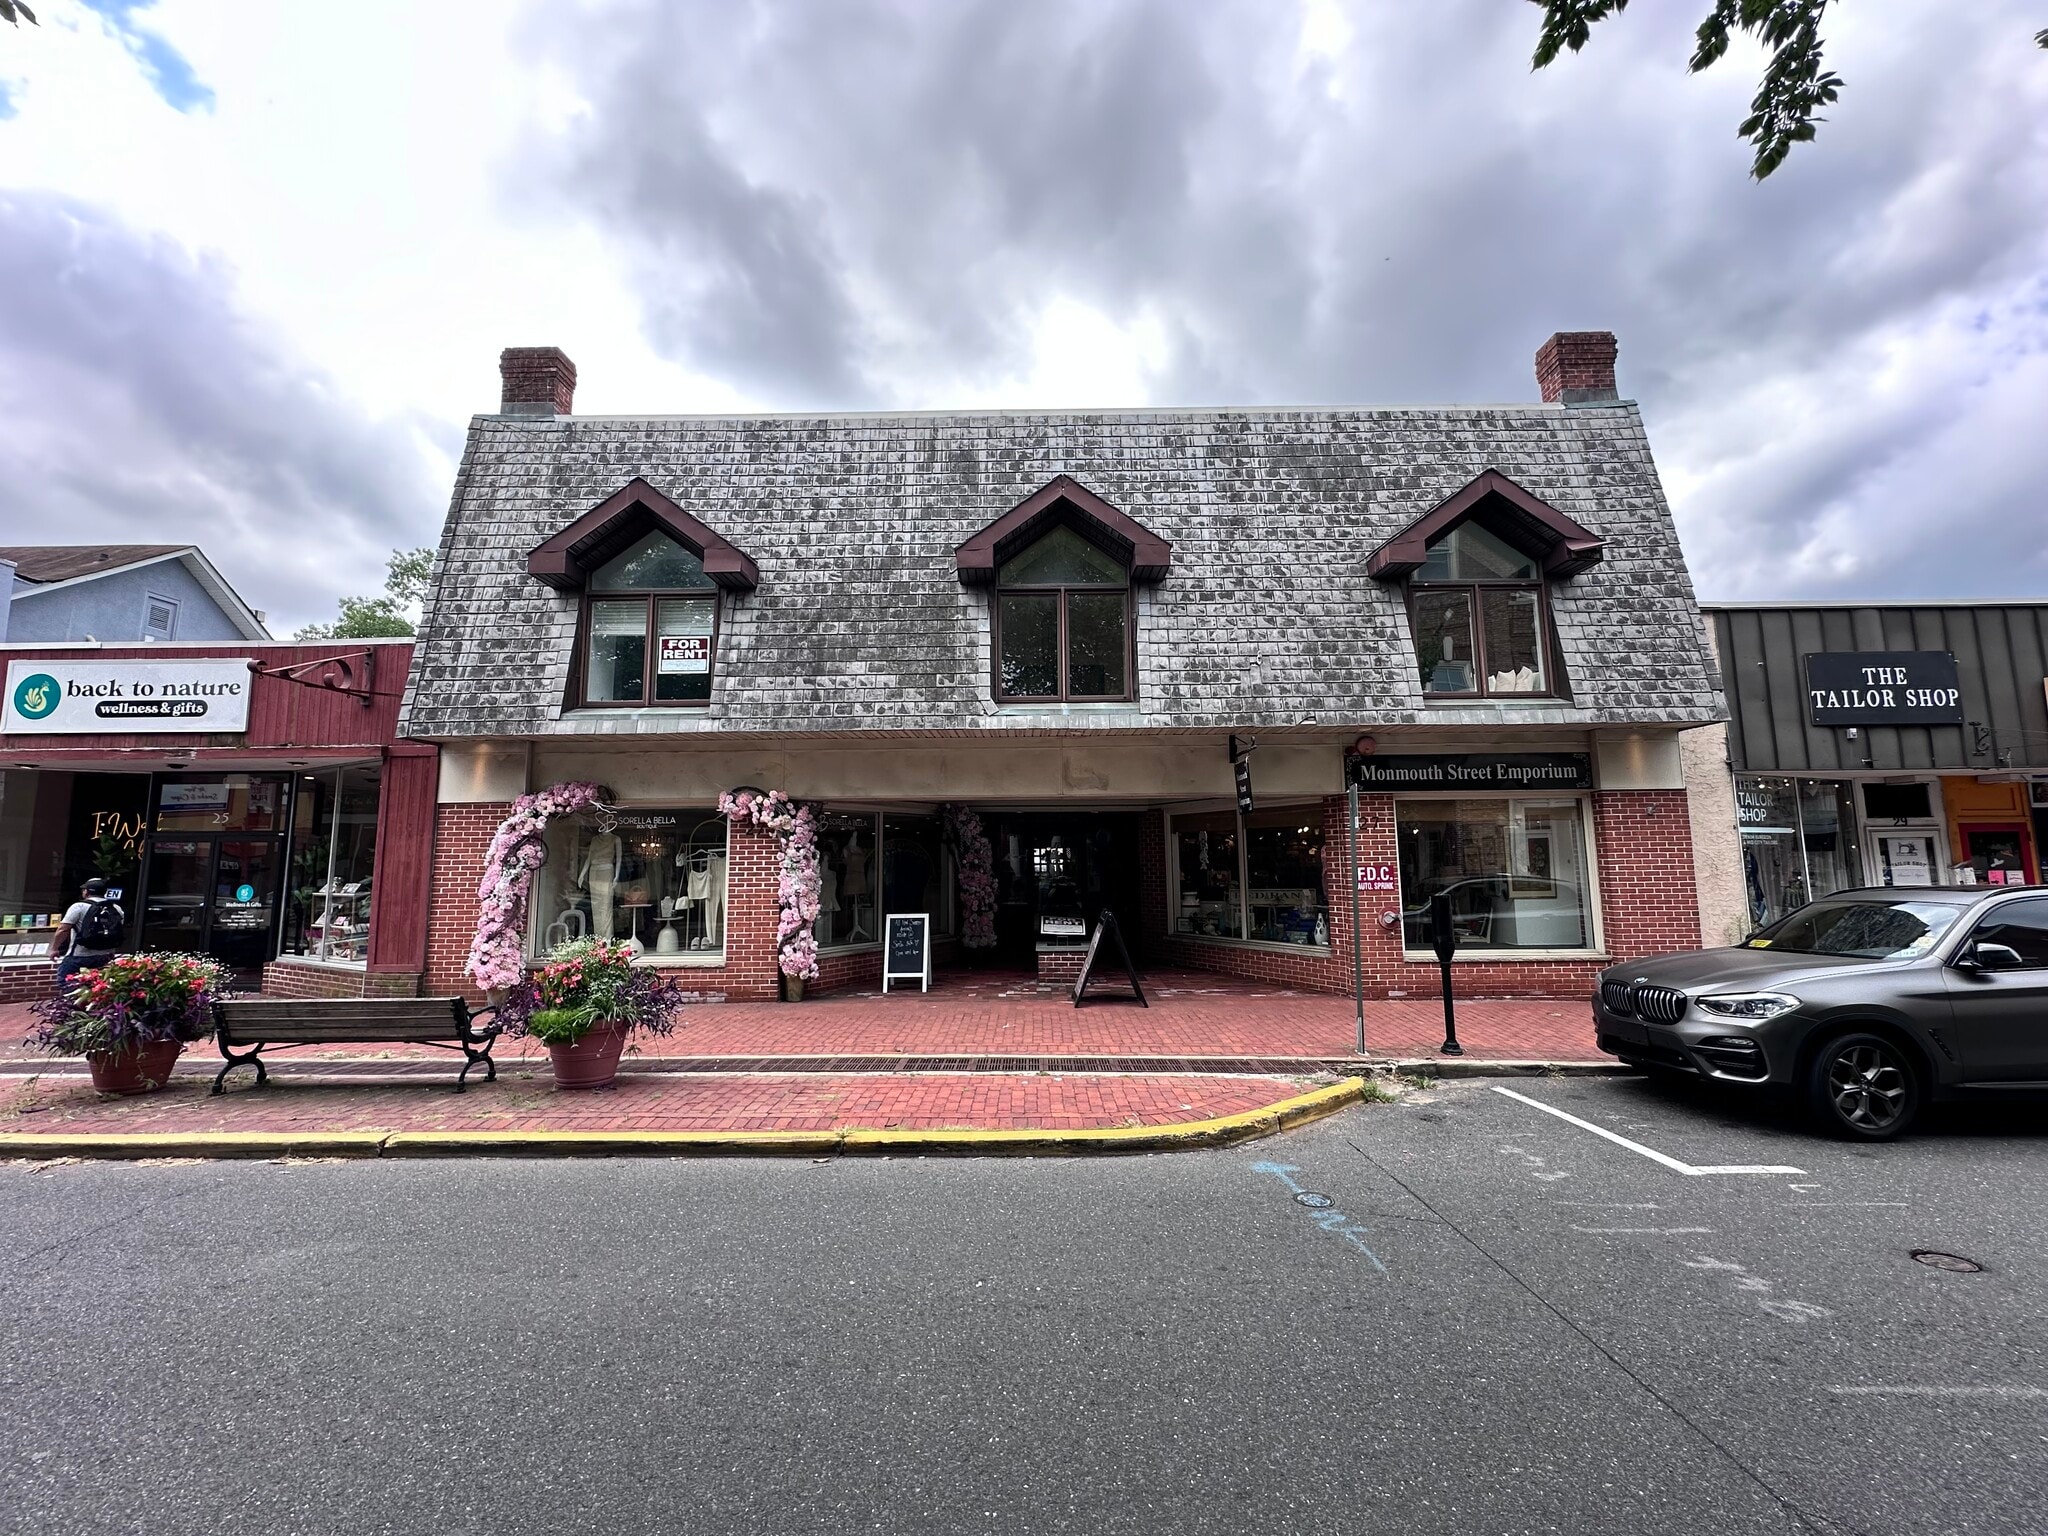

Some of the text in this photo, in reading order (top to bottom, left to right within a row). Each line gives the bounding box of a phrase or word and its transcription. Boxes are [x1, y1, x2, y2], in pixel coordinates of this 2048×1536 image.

[668, 639, 701, 649] FOR
[663, 649, 706, 659] RENT
[1862, 667, 1908, 686] THE
[67, 678, 241, 697] back to nature
[1811, 688, 1959, 709] TAILOR SHOP
[100, 702, 204, 716] wellness & gifts
[1360, 762, 1578, 783] Monmouth Street Emporium
[1738, 792, 1774, 807] TAILOR
[211, 812, 230, 824] 25
[618, 816, 677, 825] SORELLA BELLA
[1740, 808, 1767, 822] SHOP
[1893, 816, 1908, 827] 29
[1359, 816, 1379, 830] 27
[1357, 866, 1394, 881] F.D.C.
